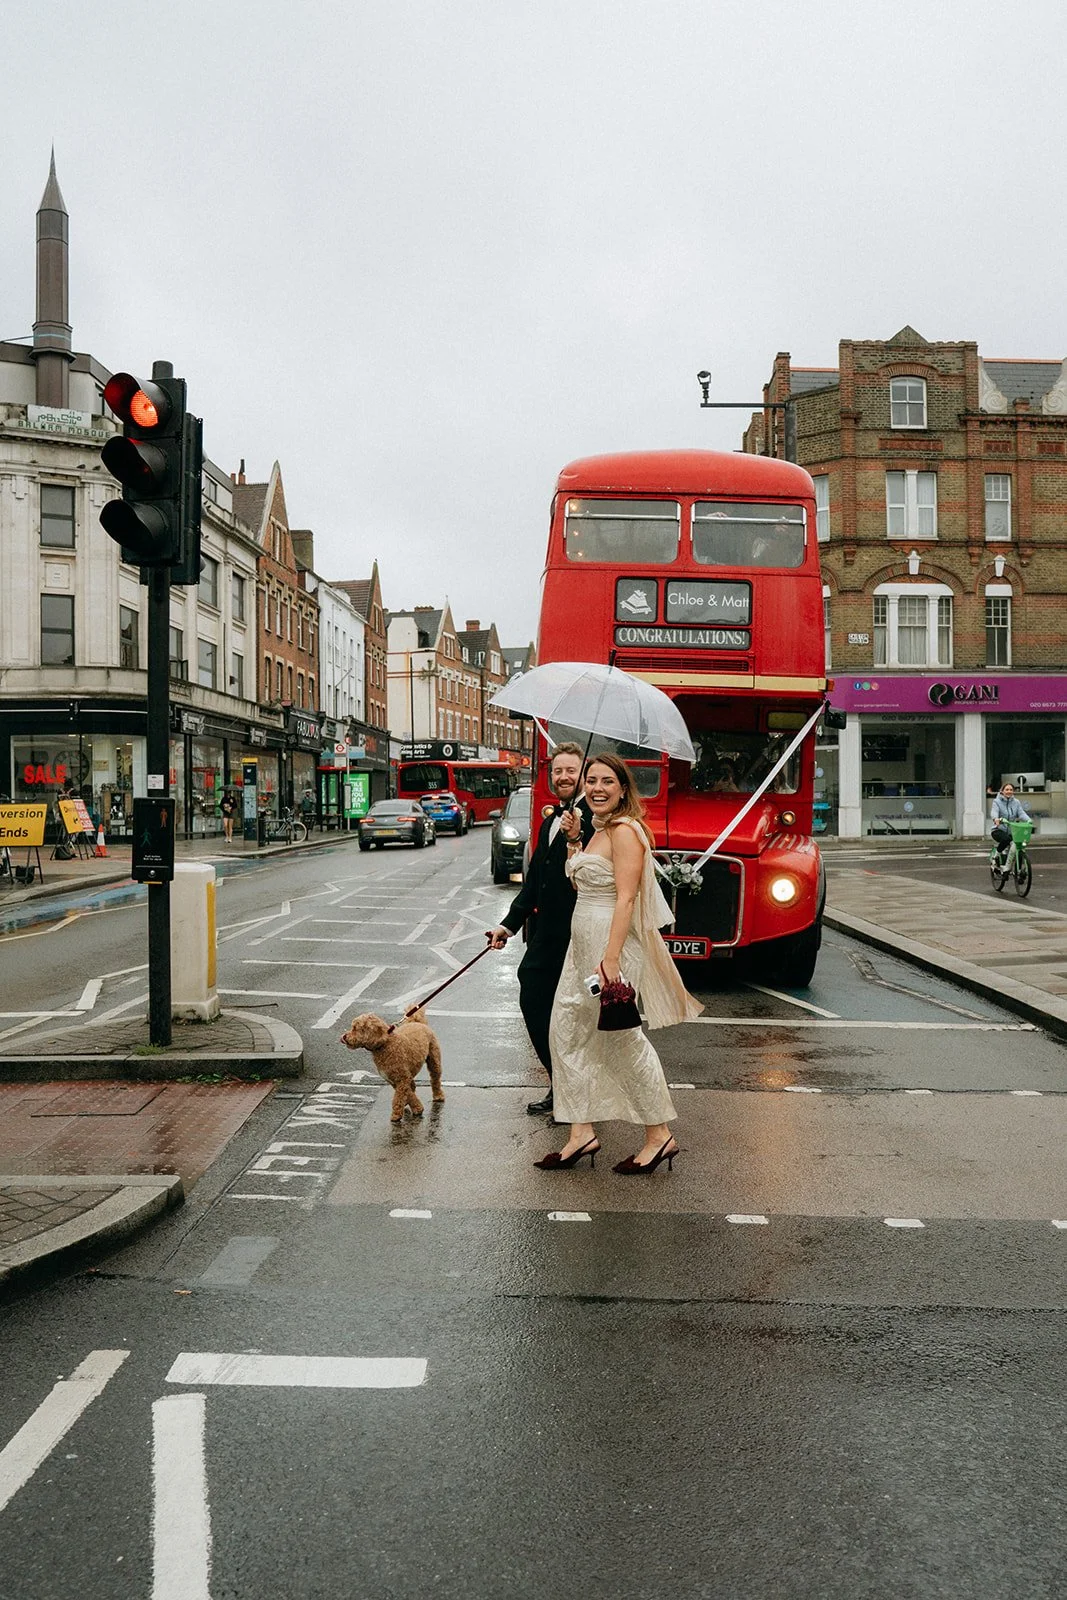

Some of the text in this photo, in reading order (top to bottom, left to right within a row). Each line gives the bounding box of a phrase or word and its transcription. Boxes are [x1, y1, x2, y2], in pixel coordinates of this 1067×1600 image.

[68, 427, 111, 438] MOSQUE
[667, 593, 749, 607] Chloe & Matt
[619, 627, 746, 645] CONGRATULATIONS!
[953, 684, 999, 700] GANI
[24, 764, 67, 784] SALE
[0, 828, 29, 838] Ends
[673, 941, 701, 954] DYE
[286, 1082, 381, 1129] LOOK
[231, 1142, 347, 1204] LEFT
